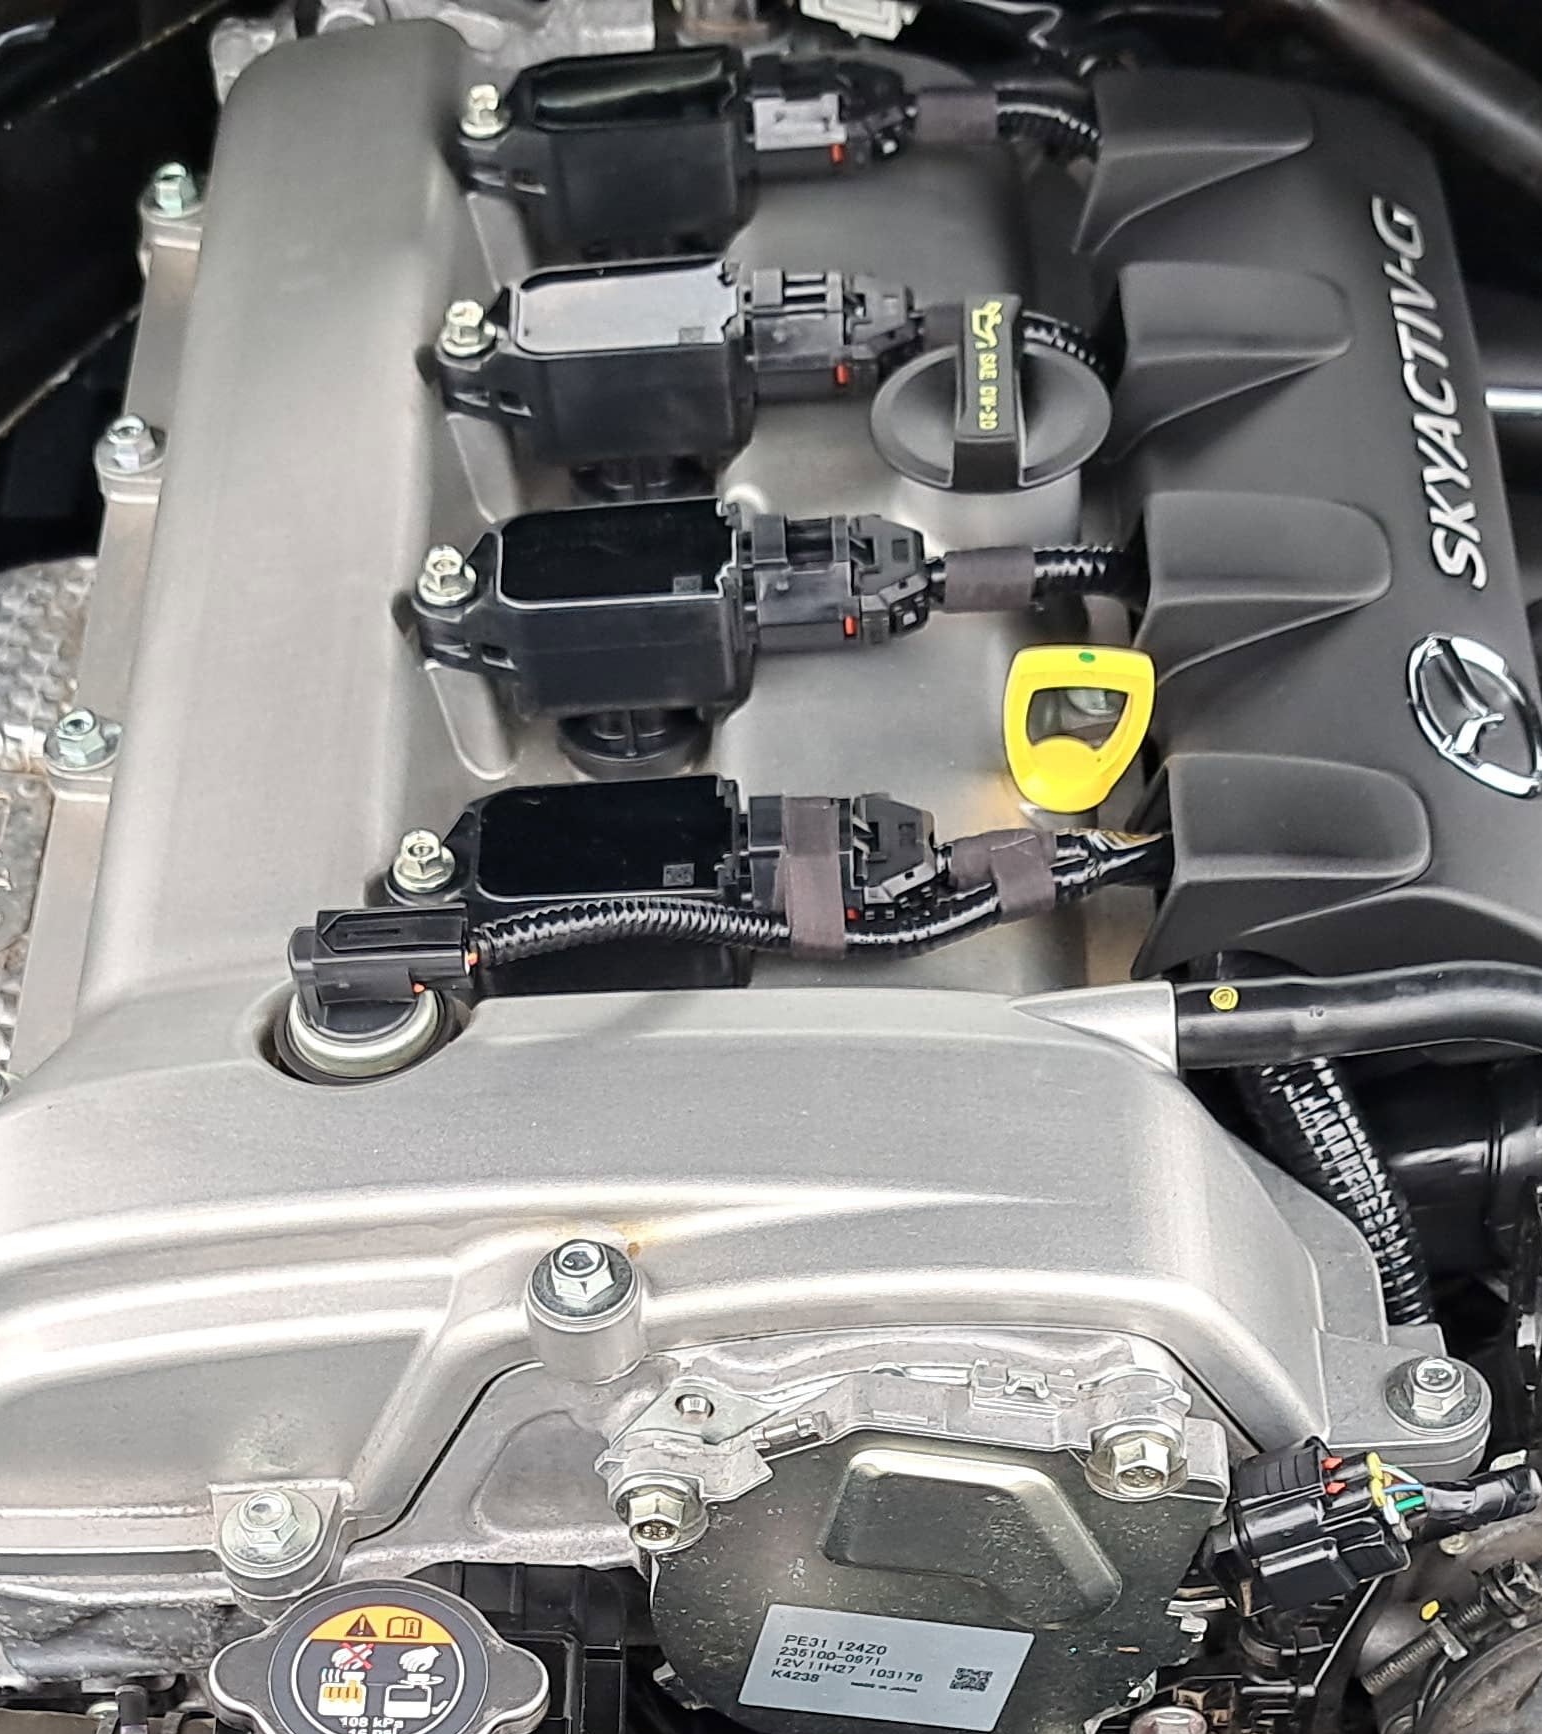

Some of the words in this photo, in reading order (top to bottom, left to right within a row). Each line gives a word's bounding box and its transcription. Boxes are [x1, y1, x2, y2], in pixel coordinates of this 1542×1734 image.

[979, 353, 997, 380] SAE
[1372, 195, 1487, 590] SKYACTIV-G
[784, 1634, 827, 1648] PE31
[778, 1646, 880, 1666] 235100-0971
[775, 1657, 804, 1668] 12V
[808, 1661, 856, 1674] 11H27
[870, 1668, 923, 1683] 103176
[339, 1717, 368, 1727] 108
[372, 1717, 404, 1729] kPa
